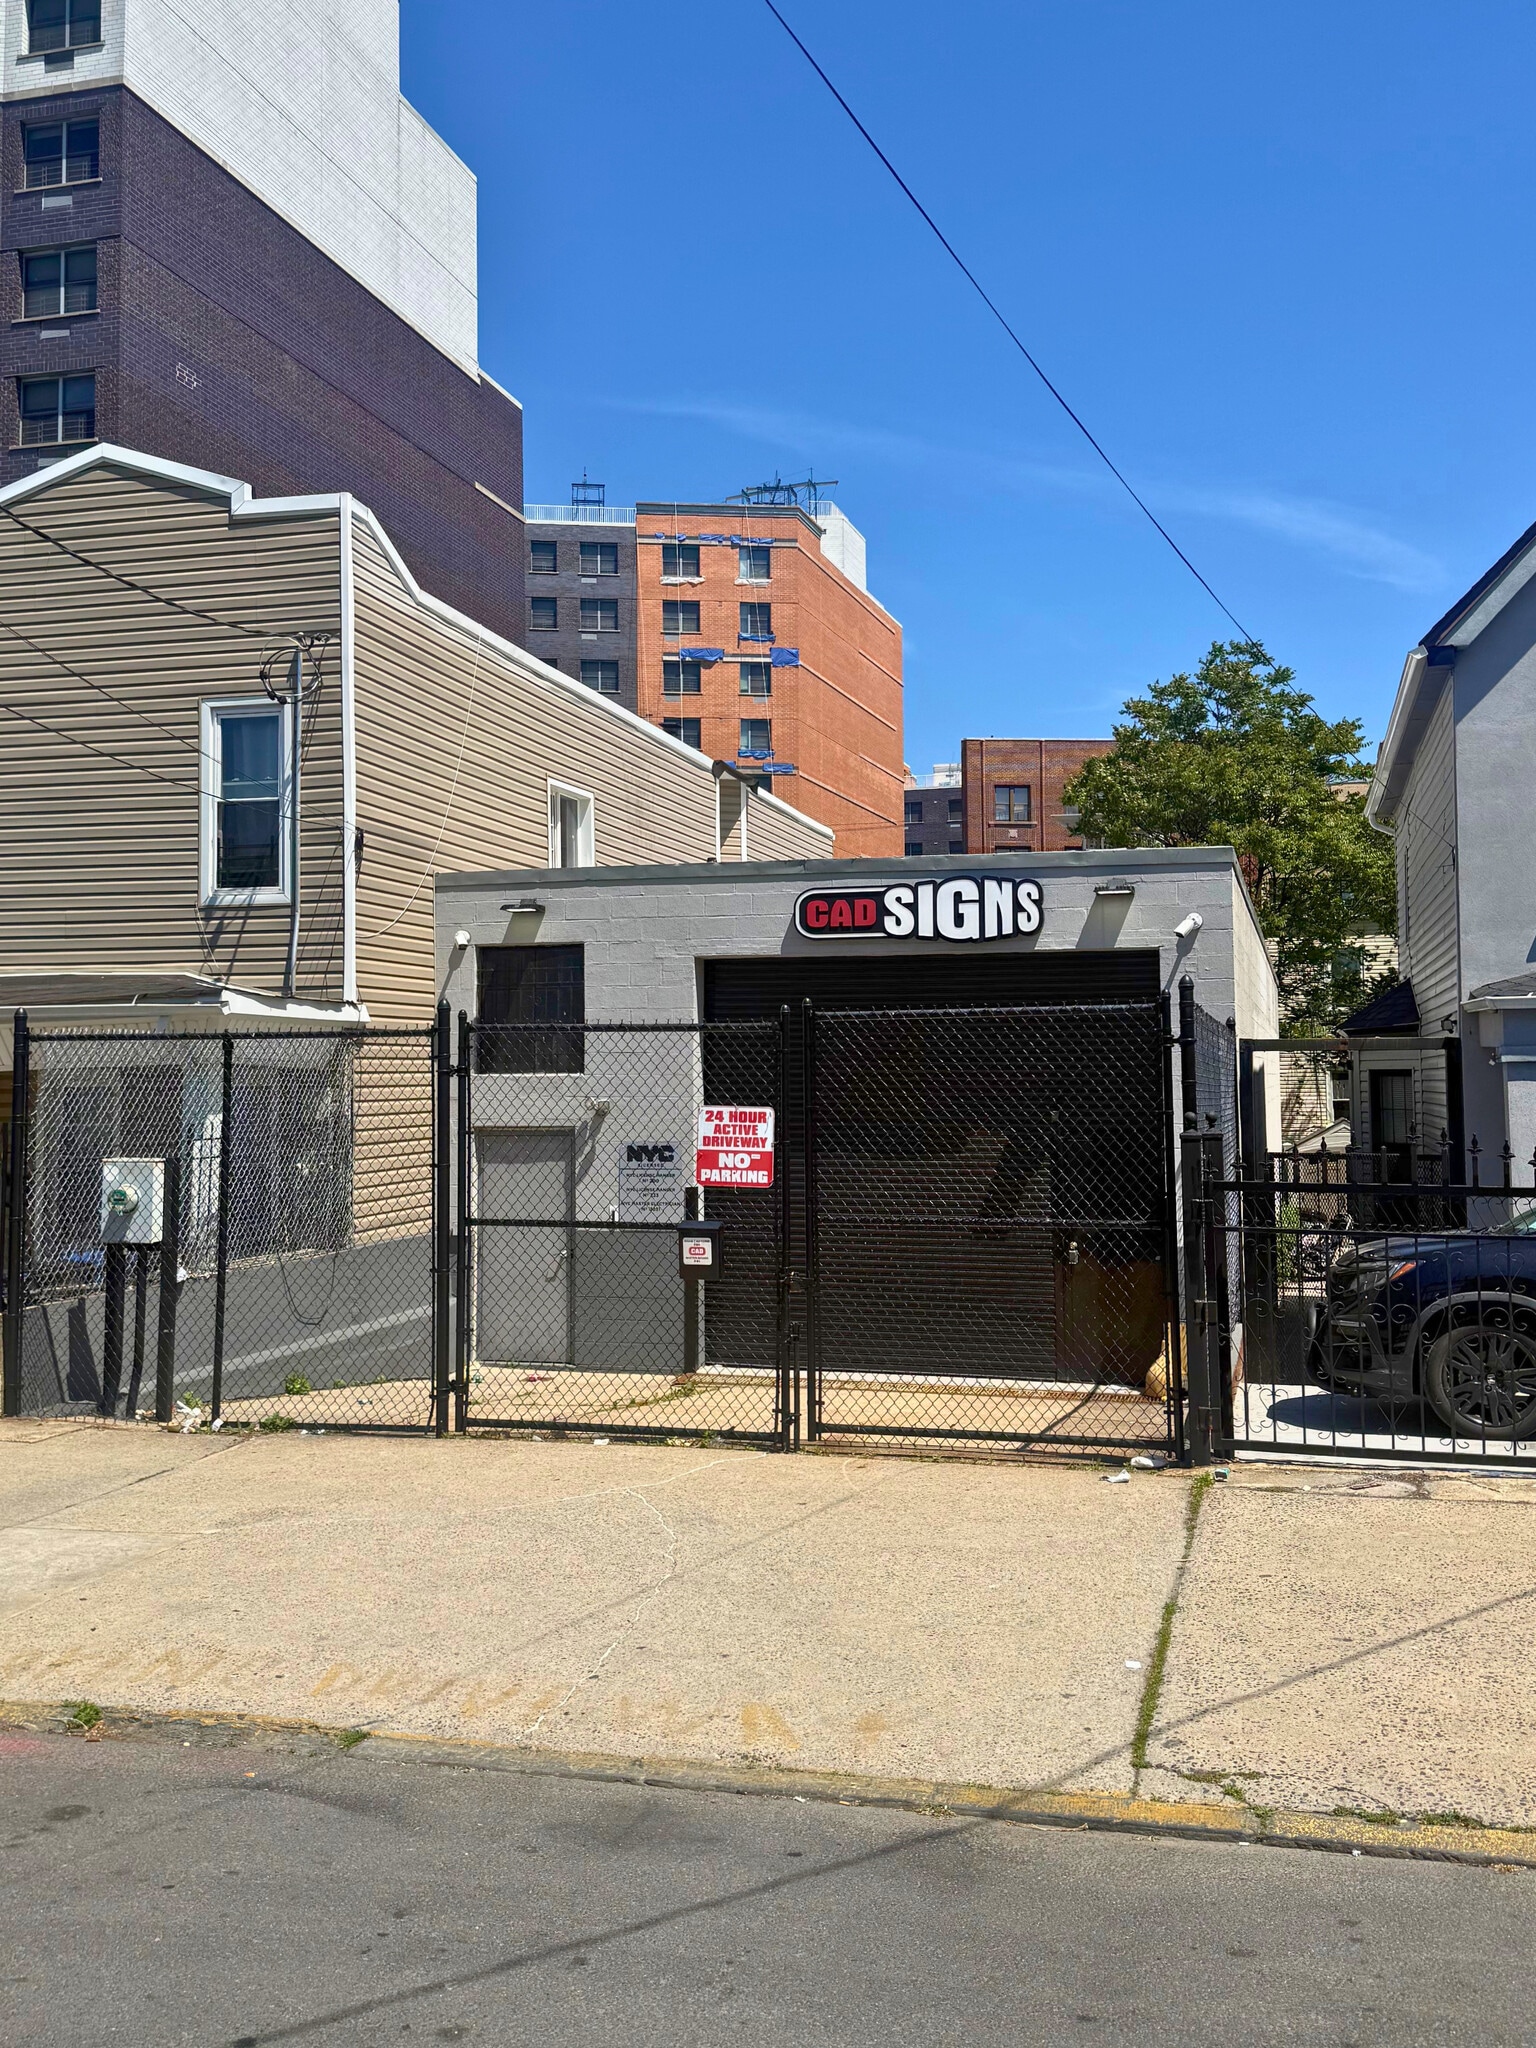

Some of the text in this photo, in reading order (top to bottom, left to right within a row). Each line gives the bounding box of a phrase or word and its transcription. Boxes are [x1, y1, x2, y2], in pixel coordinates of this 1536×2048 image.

[806, 878, 1041, 940] CAD SIGNS
[705, 1110, 767, 1124] 24 HOUR
[713, 1124, 759, 1136] ACTIVE
[702, 1135, 768, 1148] DRIVEWAY
[627, 1144, 675, 1163] NYC
[718, 1152, 751, 1169] NO
[700, 1168, 769, 1184] PARKING
